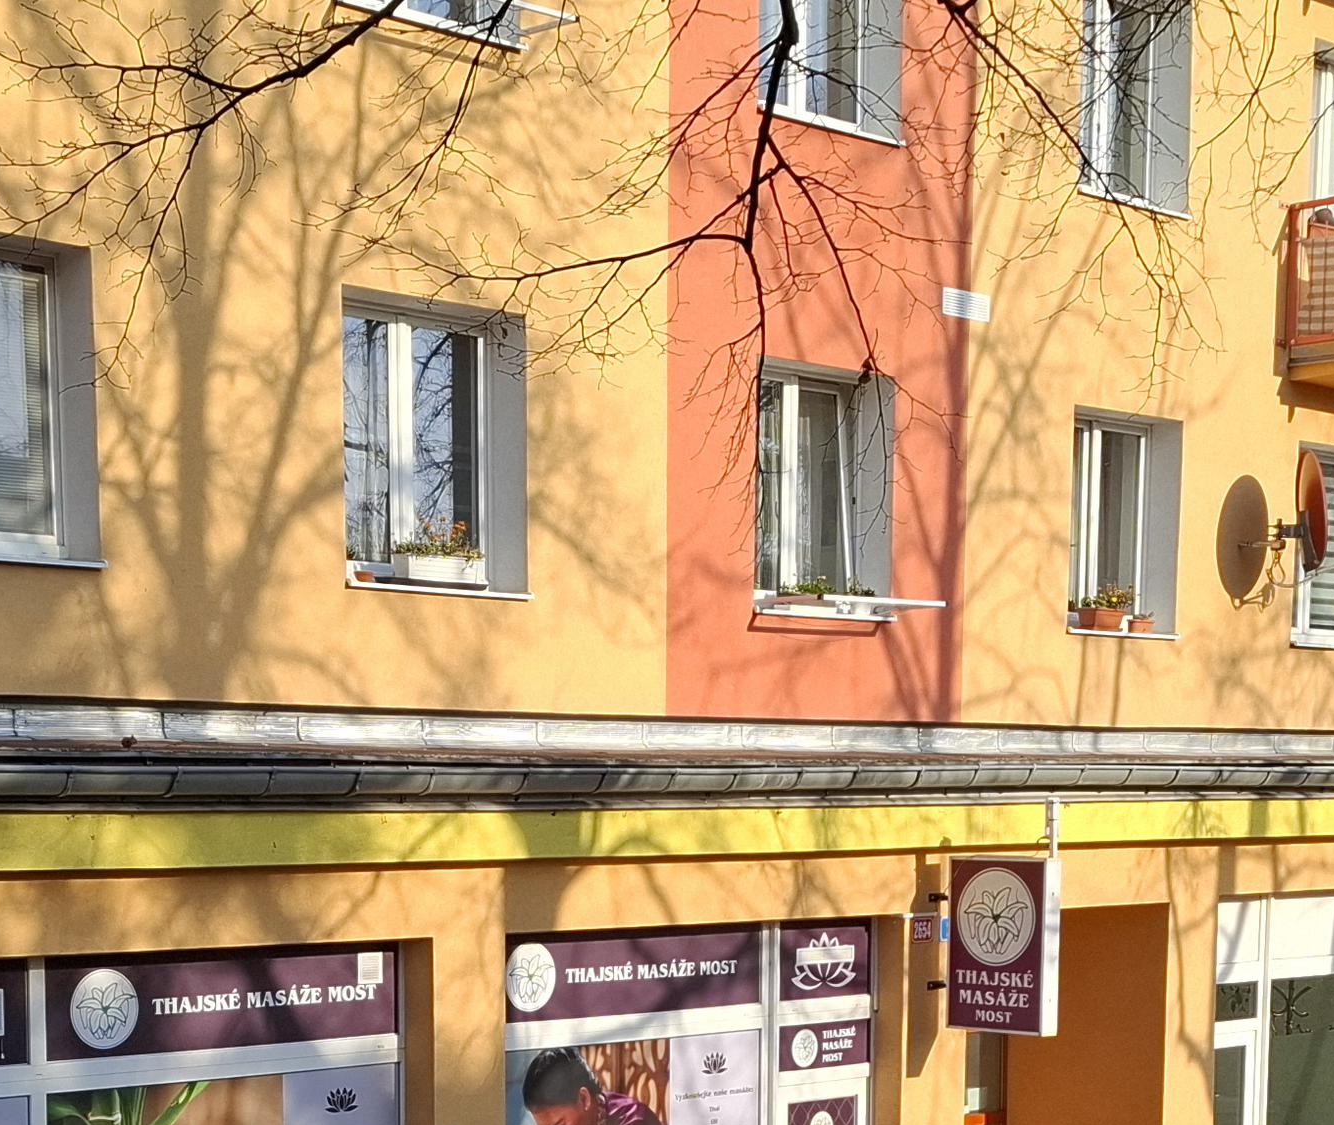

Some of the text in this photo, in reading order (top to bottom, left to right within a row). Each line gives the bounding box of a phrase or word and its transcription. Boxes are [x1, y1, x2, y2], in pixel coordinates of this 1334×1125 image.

[914, 921, 931, 939] 2654
[566, 960, 738, 983] THAJSKÉ MASÁŽE MOST
[956, 969, 1034, 988] THAJSKÉ
[152, 982, 377, 1016] THAJSKÉ MASÁŽE MOST
[959, 988, 1029, 1008] MASÁŽE
[975, 1010, 1012, 1024] MOST
[822, 1026, 856, 1039] THAJSKÉ
[822, 1039, 853, 1051] MASÁŽE
[822, 1052, 843, 1063] MOST
